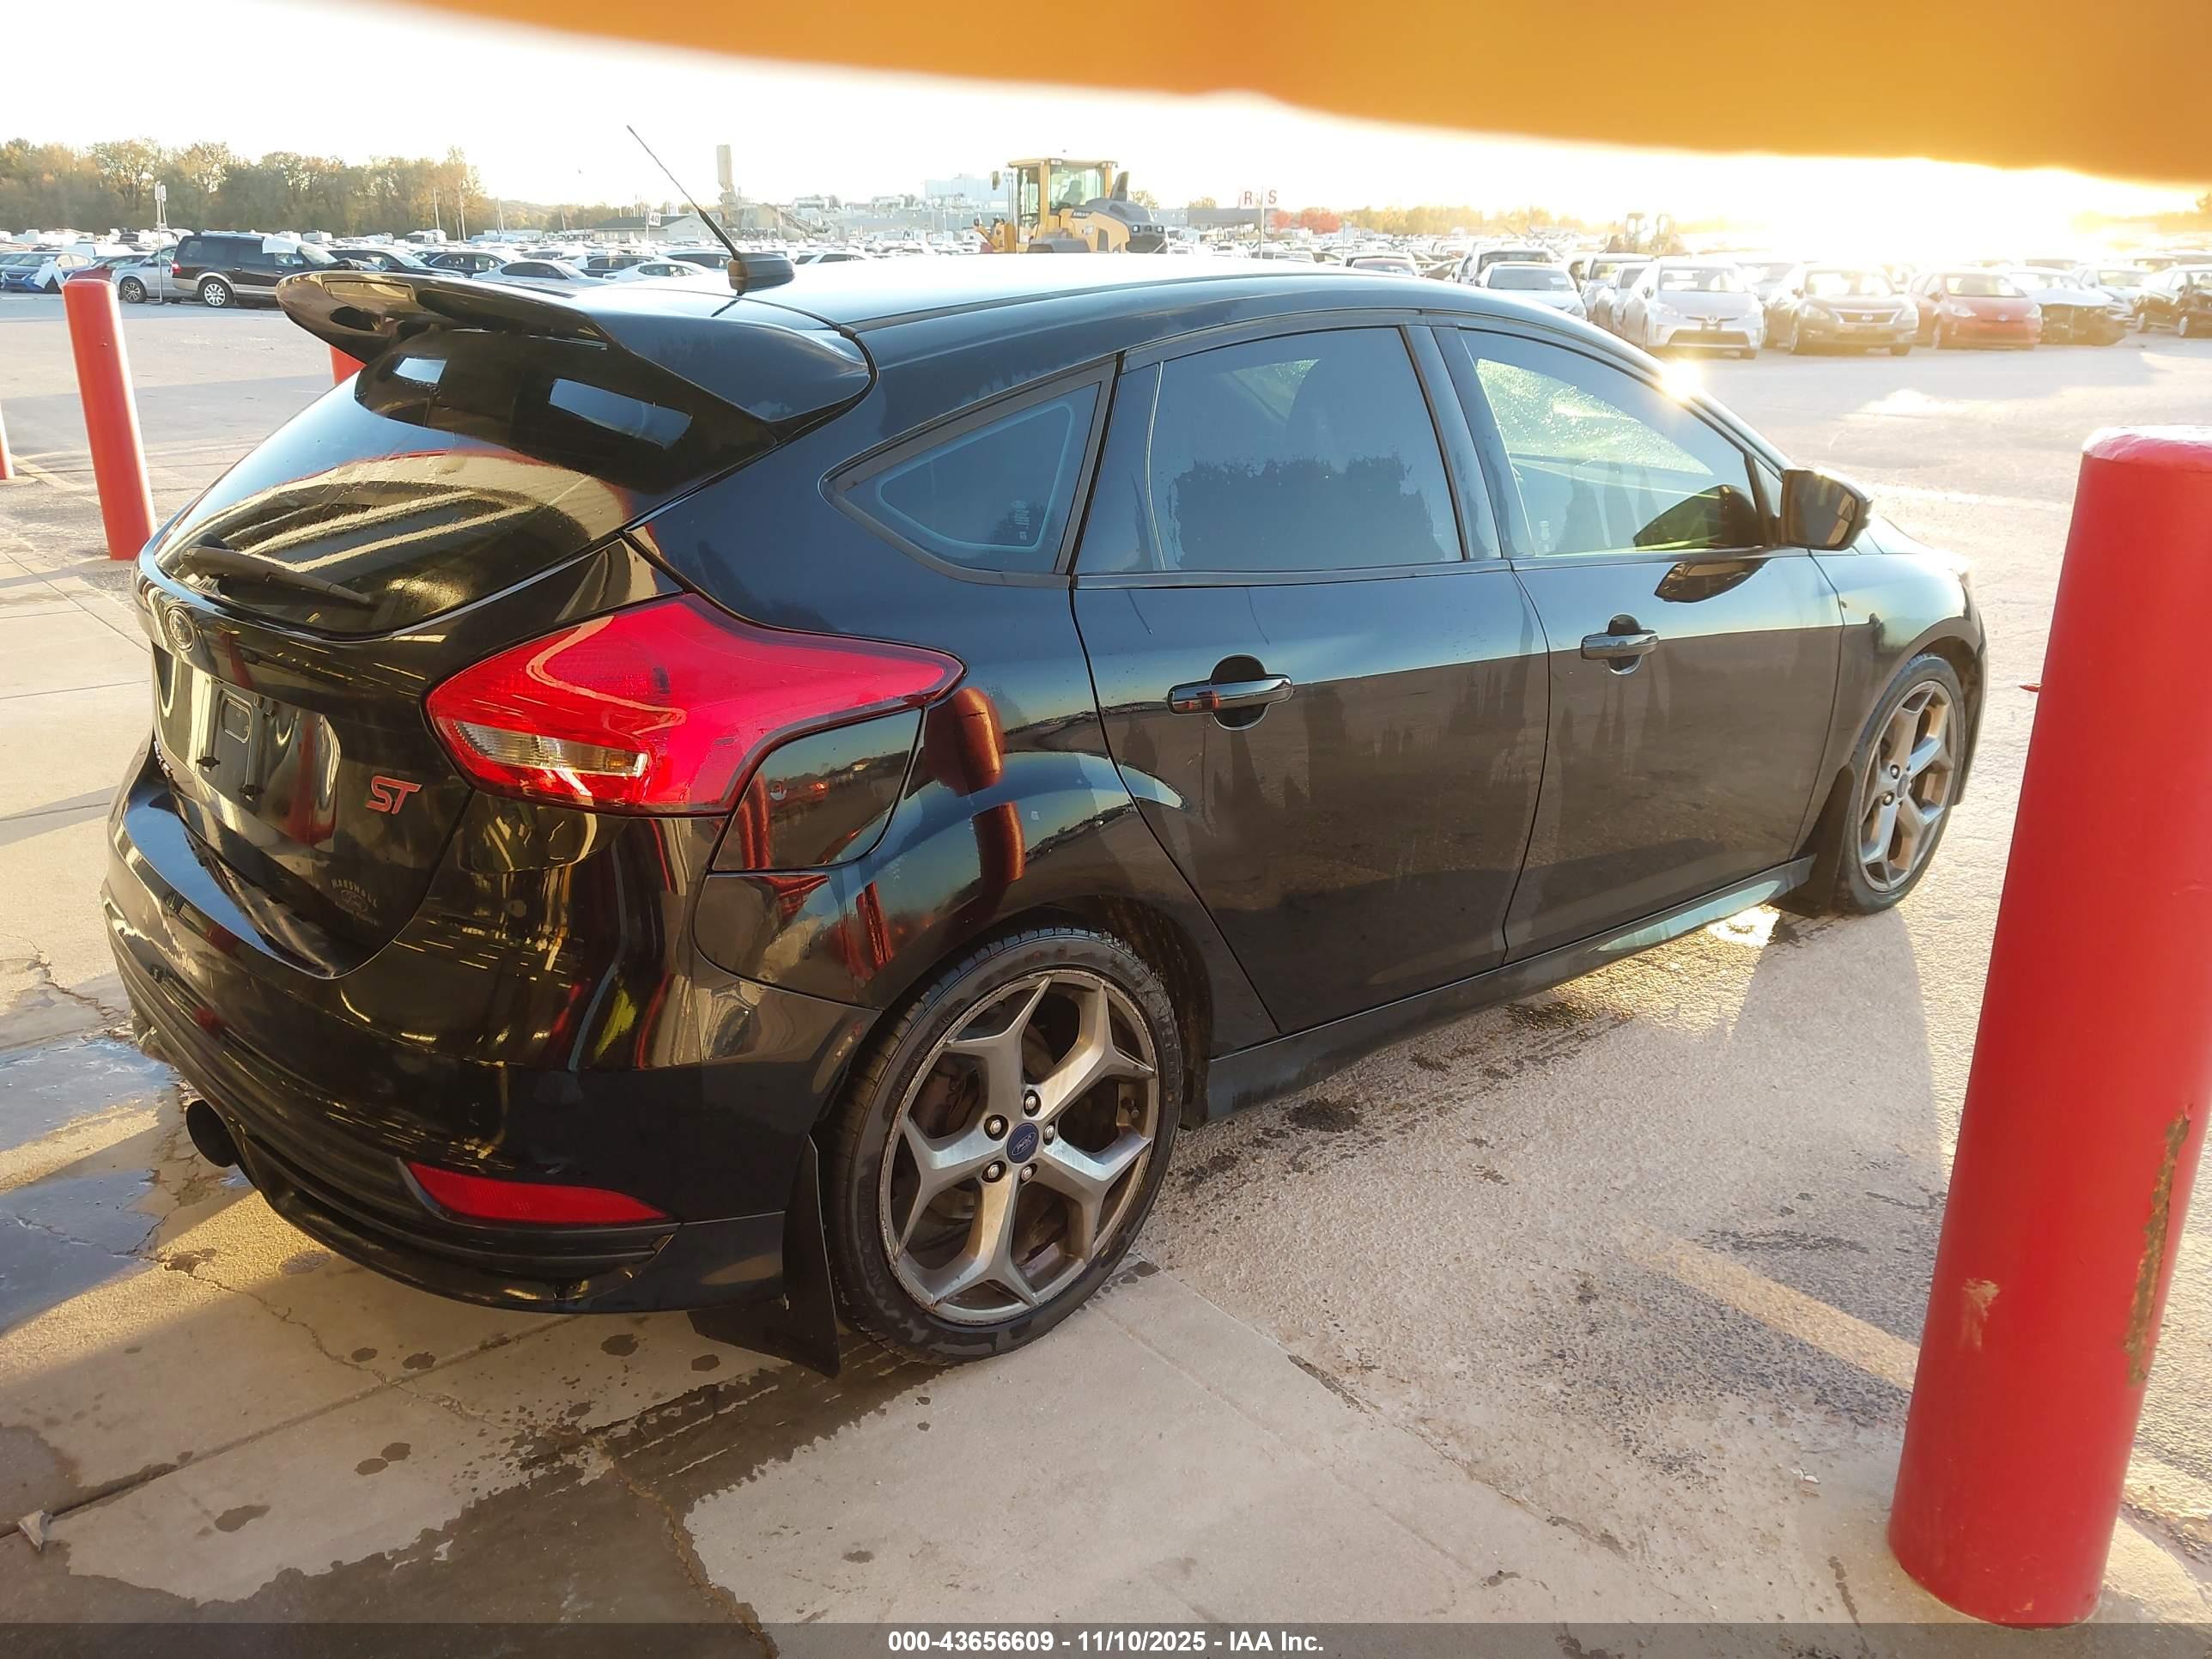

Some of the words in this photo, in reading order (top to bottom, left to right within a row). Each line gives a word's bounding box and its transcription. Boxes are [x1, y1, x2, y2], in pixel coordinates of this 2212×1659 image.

[1244, 191, 1252, 205] R
[1268, 190, 1278, 204] S
[651, 215, 659, 223] 40
[366, 775, 422, 815] ST
[331, 878, 378, 908] MARSHALL
